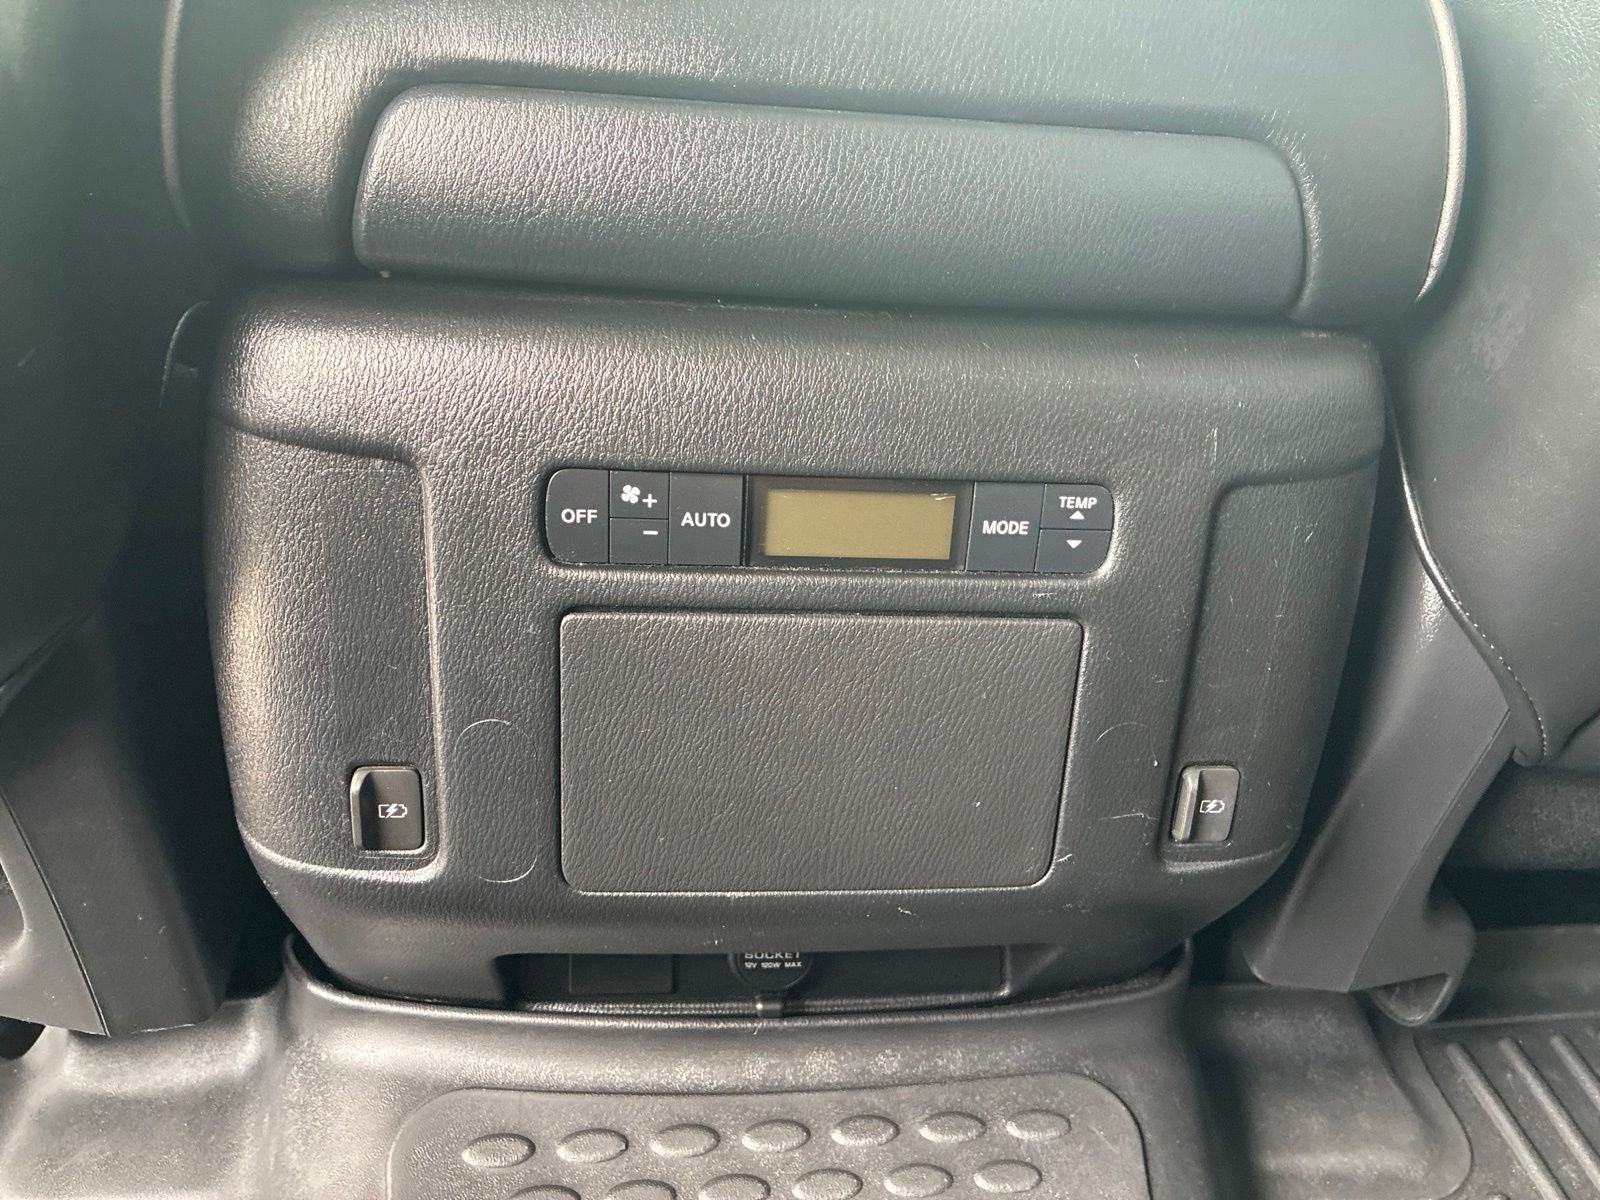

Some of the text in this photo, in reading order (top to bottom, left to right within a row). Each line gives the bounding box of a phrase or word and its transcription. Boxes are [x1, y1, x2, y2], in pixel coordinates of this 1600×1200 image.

[1058, 496, 1098, 509] TEMP
[561, 508, 598, 524] OFF
[680, 512, 731, 528] AUTO
[982, 520, 1030, 535] MODE
[744, 961, 758, 969] 12V
[784, 961, 802, 969] MAX
